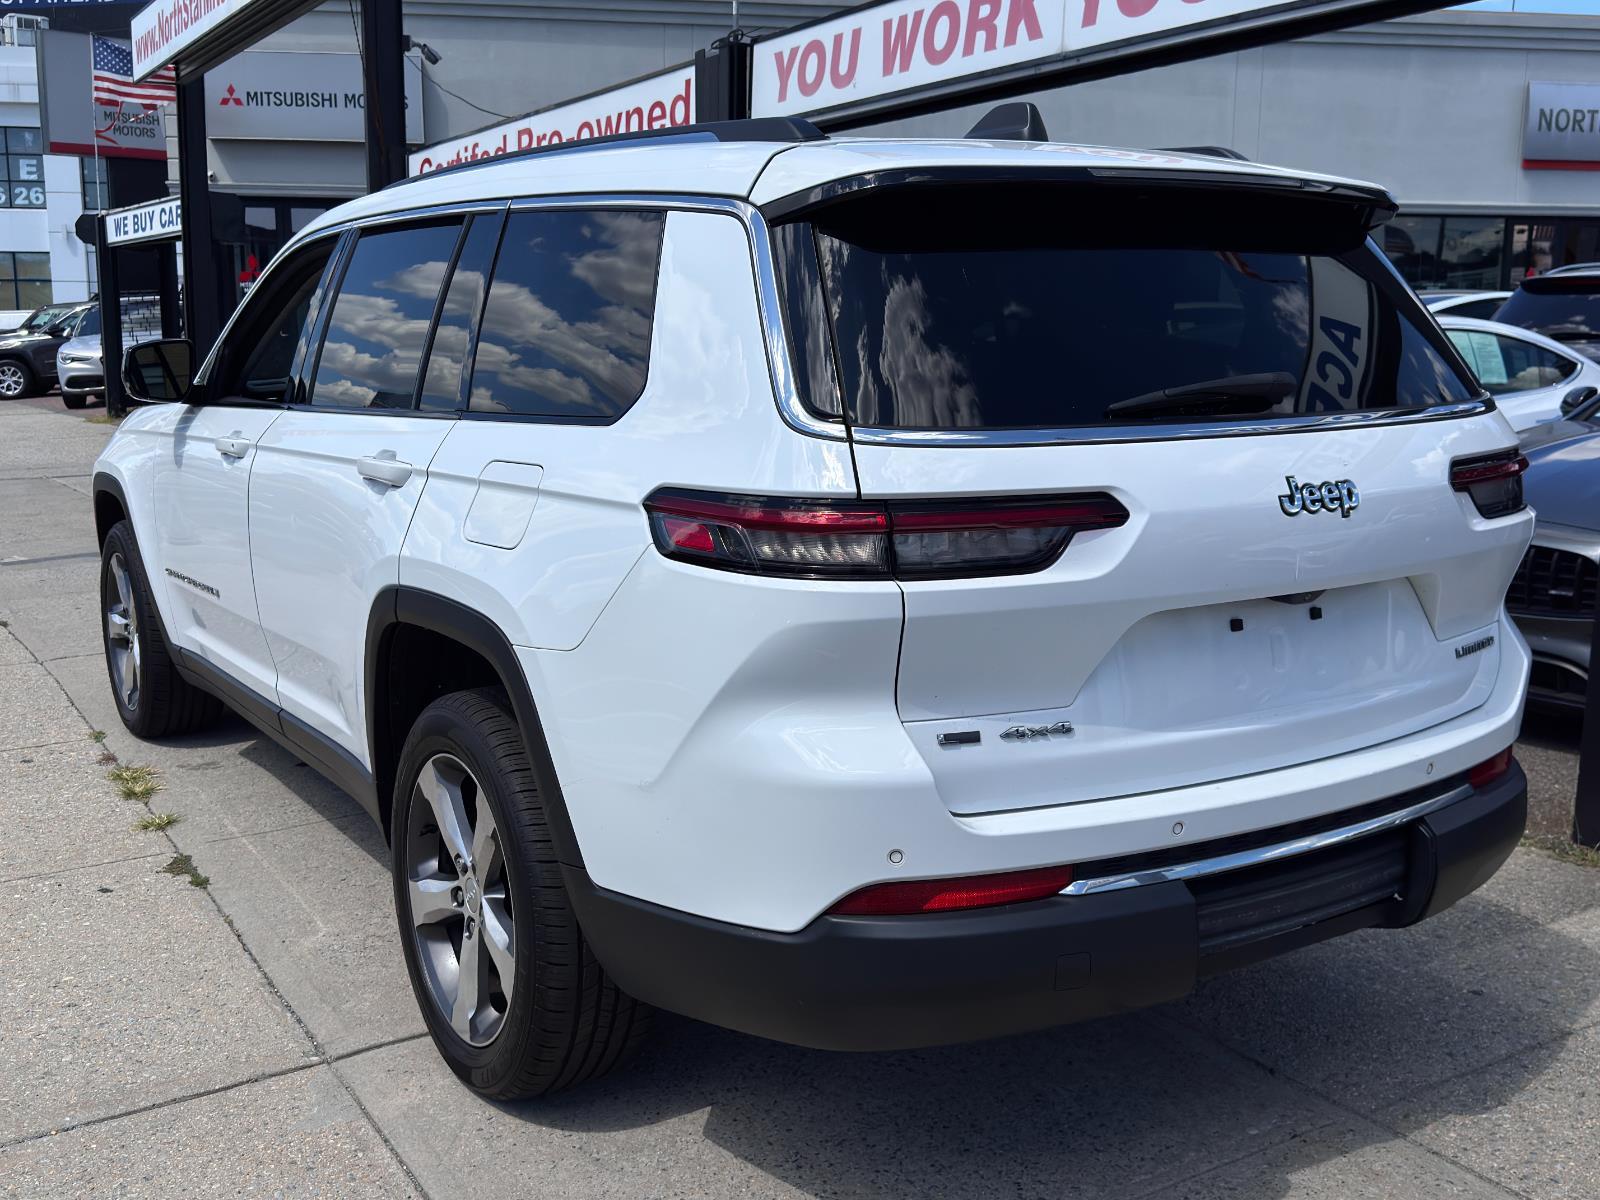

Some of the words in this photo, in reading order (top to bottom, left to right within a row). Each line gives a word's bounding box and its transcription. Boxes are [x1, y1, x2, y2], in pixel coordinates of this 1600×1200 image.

[135, 0, 225, 65] www.NorthStar
[773, 27, 862, 103] YOU
[882, 0, 1043, 77] WORK
[246, 91, 337, 108] MITSUBISHI
[344, 93, 409, 110] MOS
[112, 125, 156, 138] MOTORS
[1537, 108, 1600, 133] NORT
[114, 216, 129, 237] WE
[132, 210, 155, 234] BUY
[1278, 475, 1360, 518] Jeep
[999, 721, 1074, 740] 4x4
